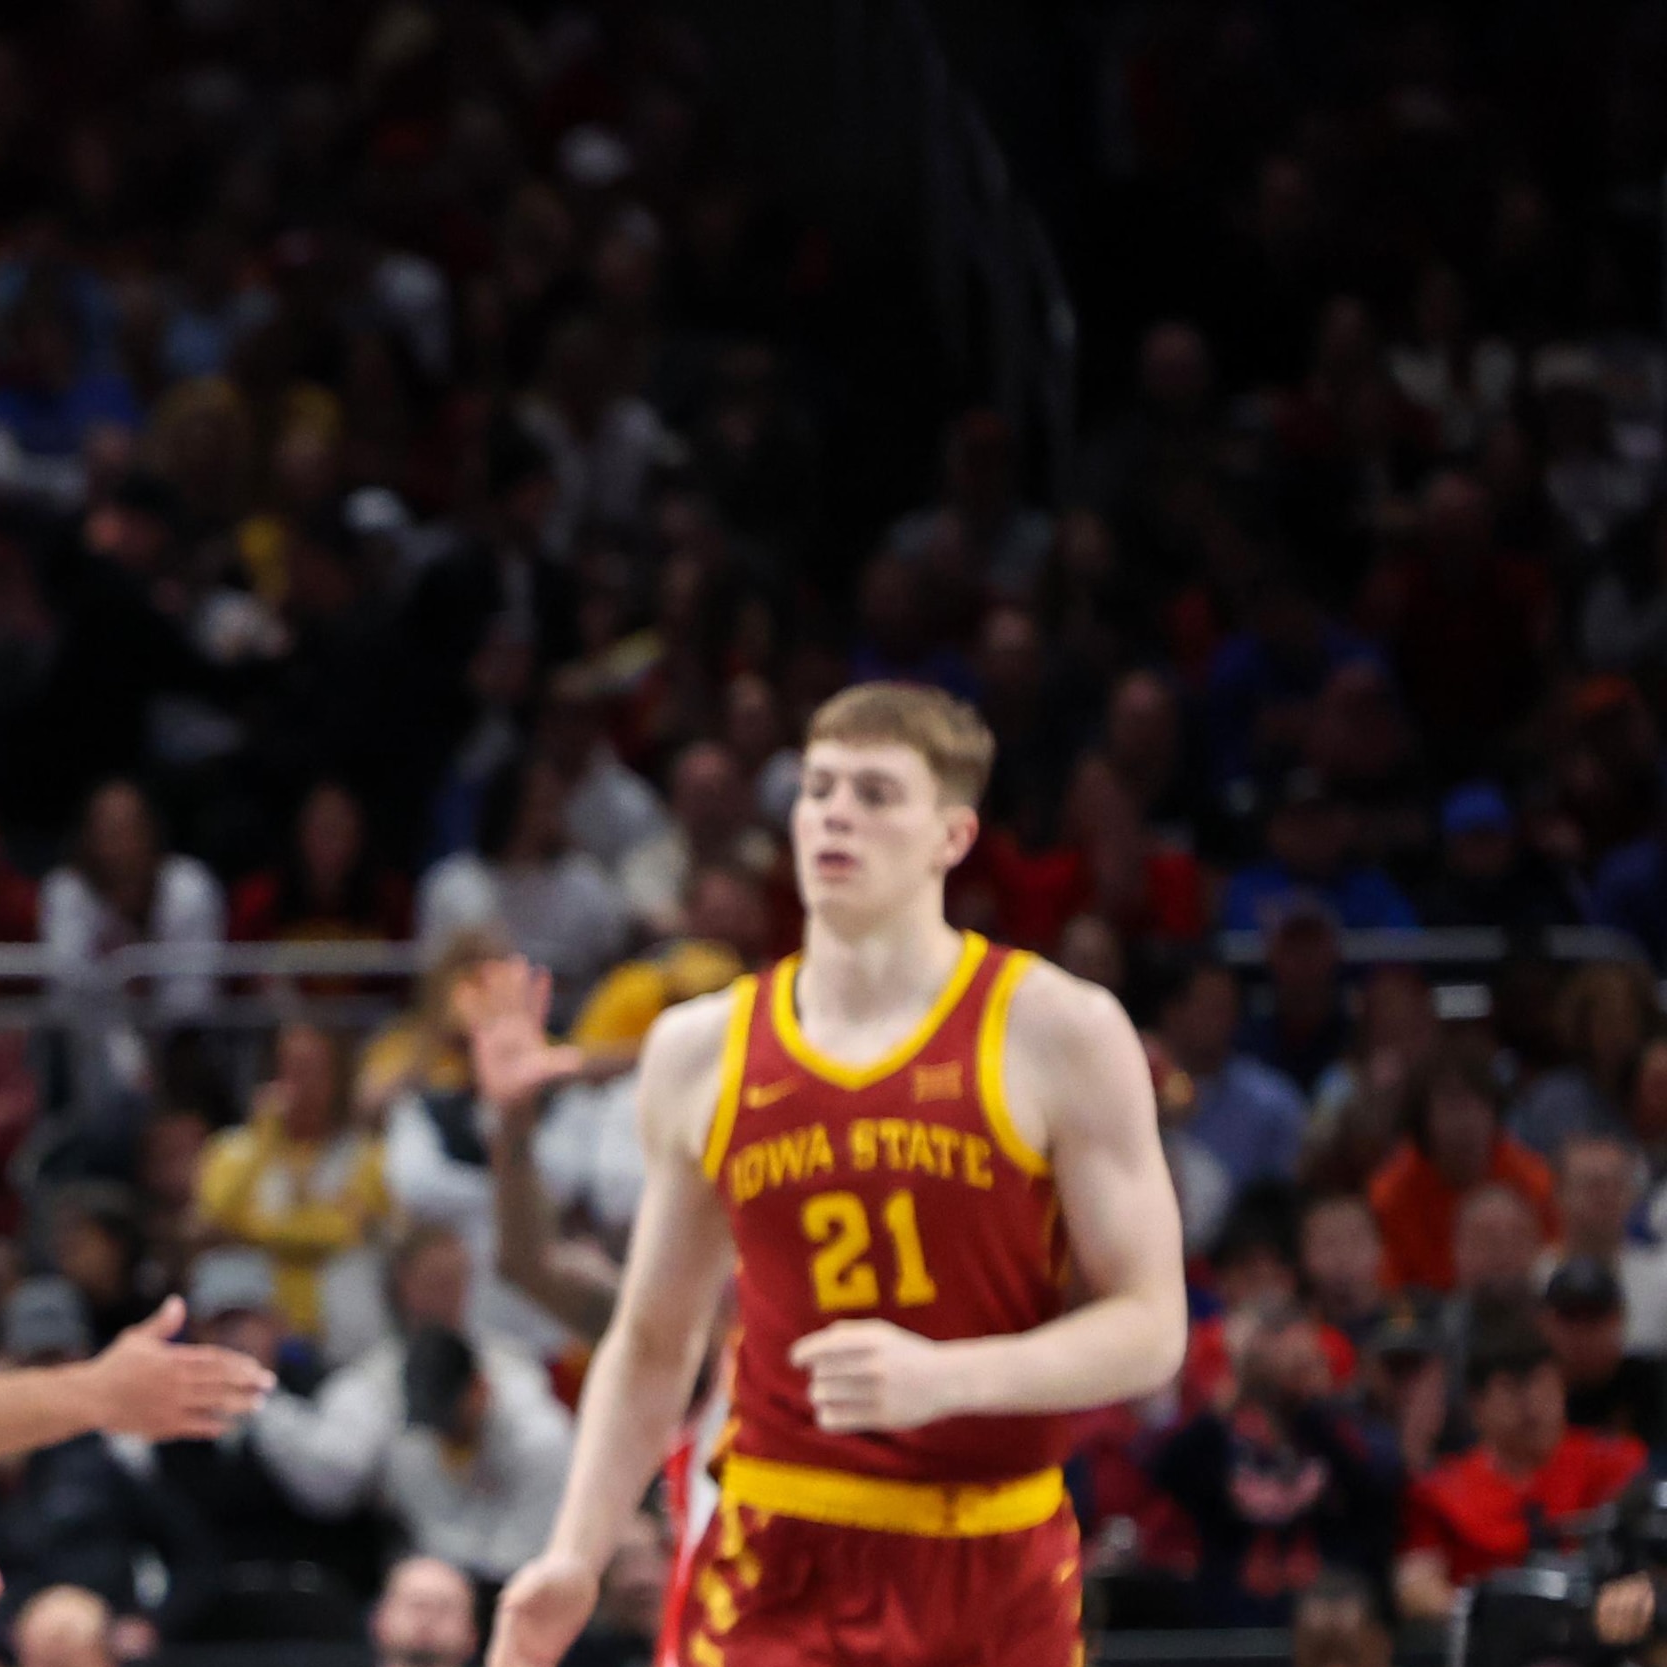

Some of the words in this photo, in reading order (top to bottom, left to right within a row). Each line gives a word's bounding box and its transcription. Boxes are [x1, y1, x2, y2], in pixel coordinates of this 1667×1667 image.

[730, 1121, 835, 1206] IOWA
[848, 1116, 996, 1191] STATE
[800, 1187, 937, 1313] 21
